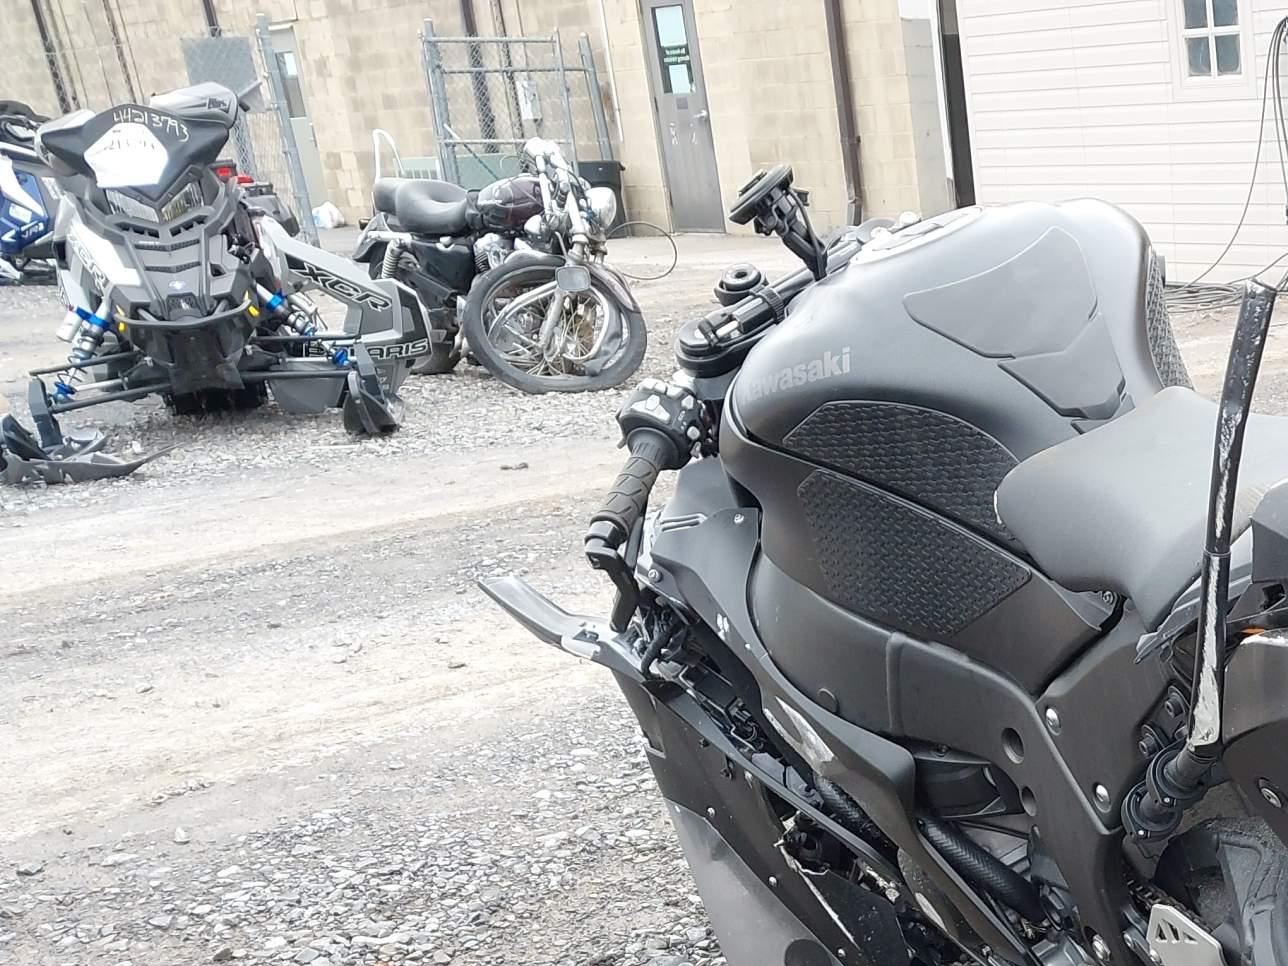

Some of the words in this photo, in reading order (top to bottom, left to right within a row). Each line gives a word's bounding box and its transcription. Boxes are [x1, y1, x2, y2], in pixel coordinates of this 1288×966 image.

[112, 107, 190, 143] 44213793
[287, 260, 393, 312] XCR
[302, 338, 429, 360] PARIS
